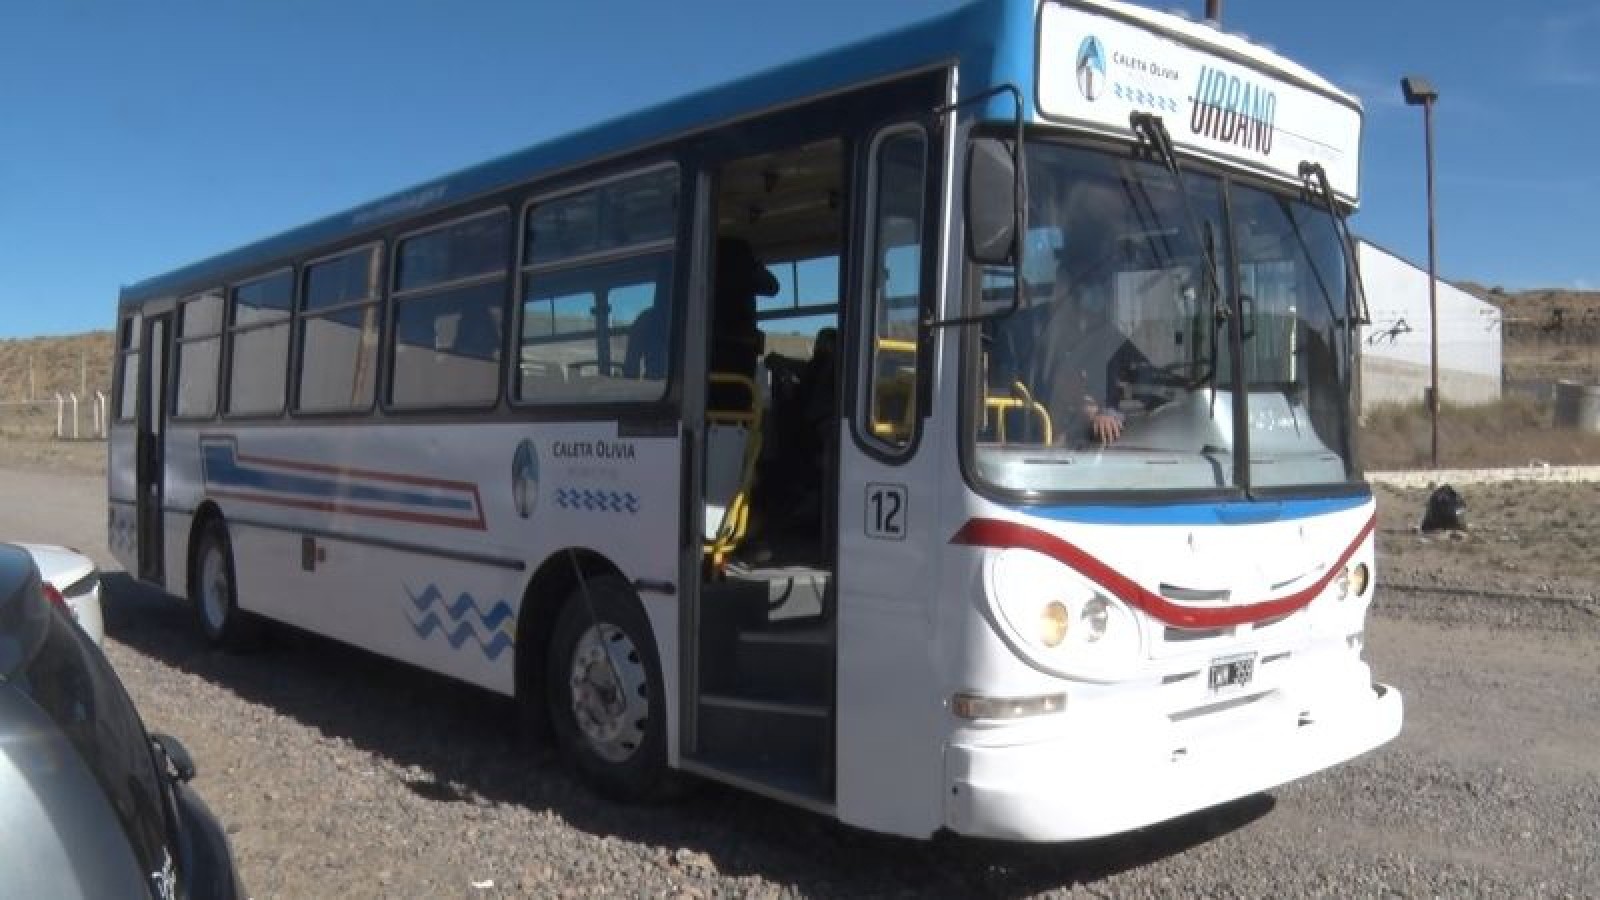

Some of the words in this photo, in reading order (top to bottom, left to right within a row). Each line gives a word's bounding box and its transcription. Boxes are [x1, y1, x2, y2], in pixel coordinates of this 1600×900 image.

[1190, 64, 1277, 155] URBANO
[552, 440, 592, 458] CALETA
[596, 440, 635, 459] OLIVIA
[871, 490, 901, 533] 12
